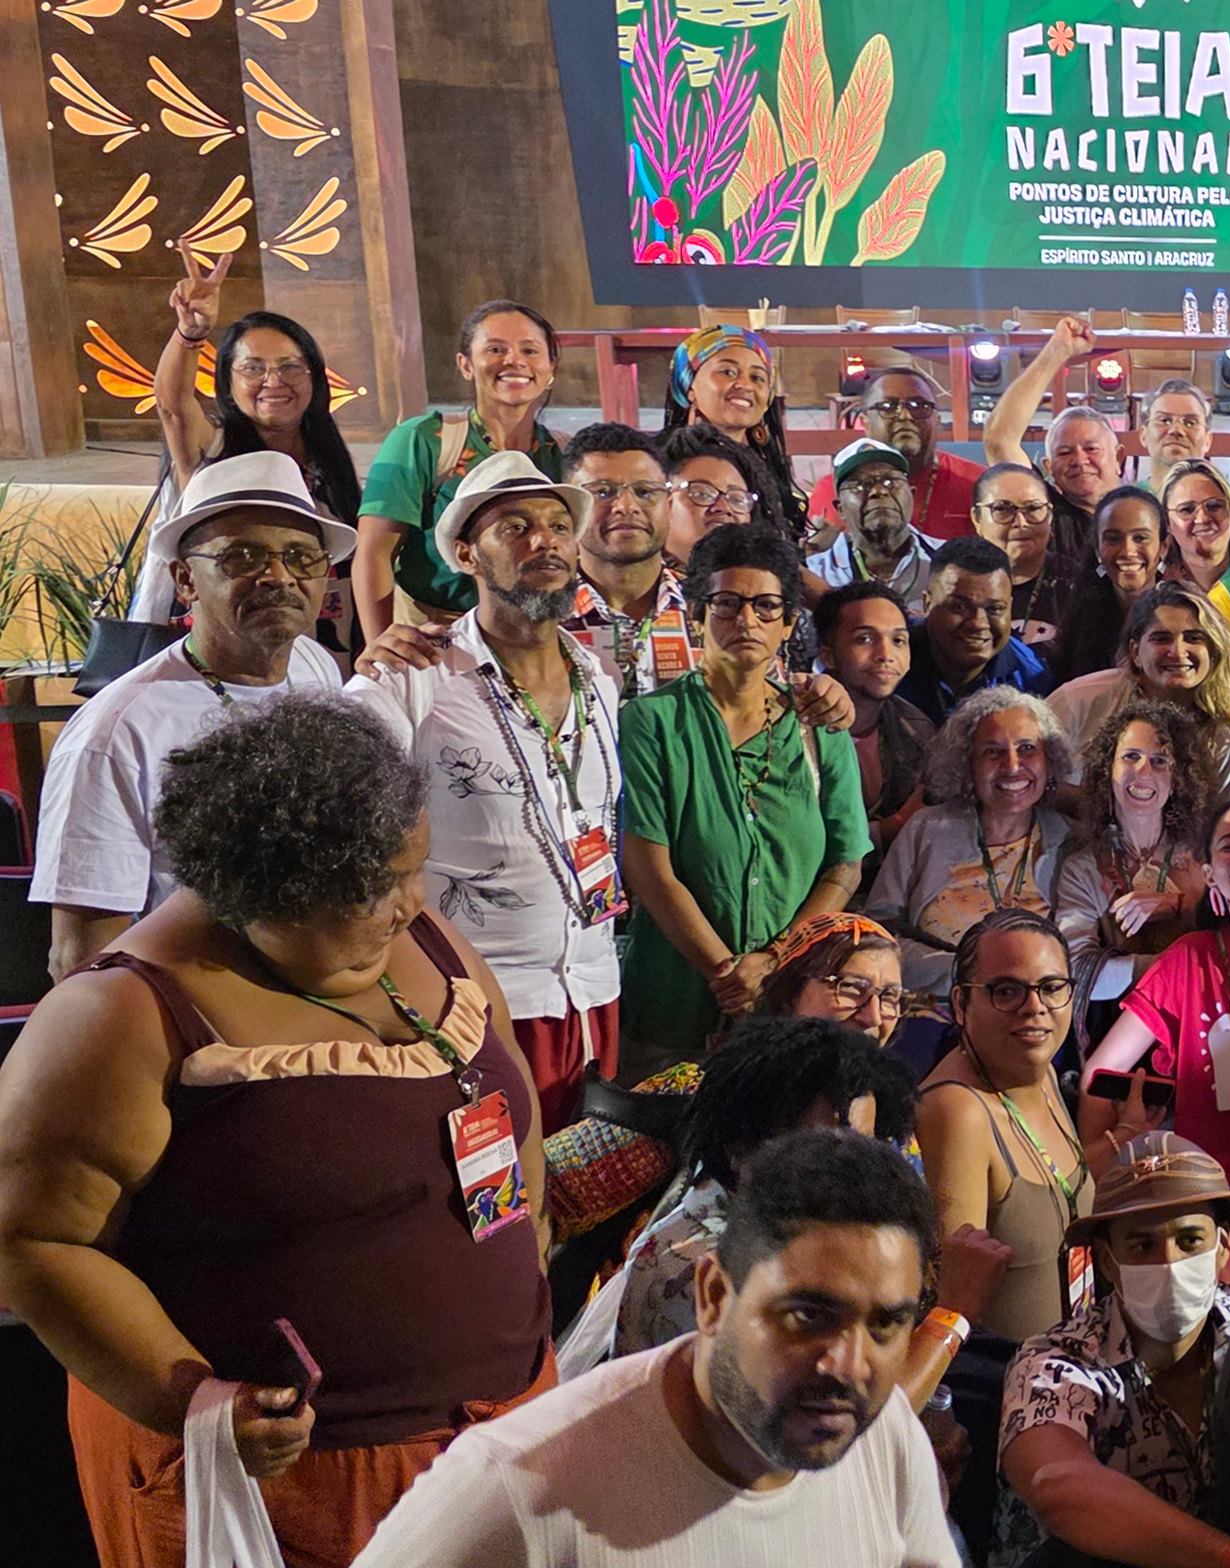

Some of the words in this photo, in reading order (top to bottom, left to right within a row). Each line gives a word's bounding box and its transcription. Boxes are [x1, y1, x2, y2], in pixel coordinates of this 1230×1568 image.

[1009, 182, 1083, 202] PONTOS
[1089, 184, 1110, 203] DE
[1113, 185, 1195, 205] CULTURA
[1038, 206, 1116, 229] JUSTIÇA
[1119, 205, 1216, 228] CLIMÁTICA
[1040, 247, 1099, 264] ESPÍRITO
[1101, 250, 1146, 266] SANTO
[1154, 251, 1215, 267] ARACRUZ
